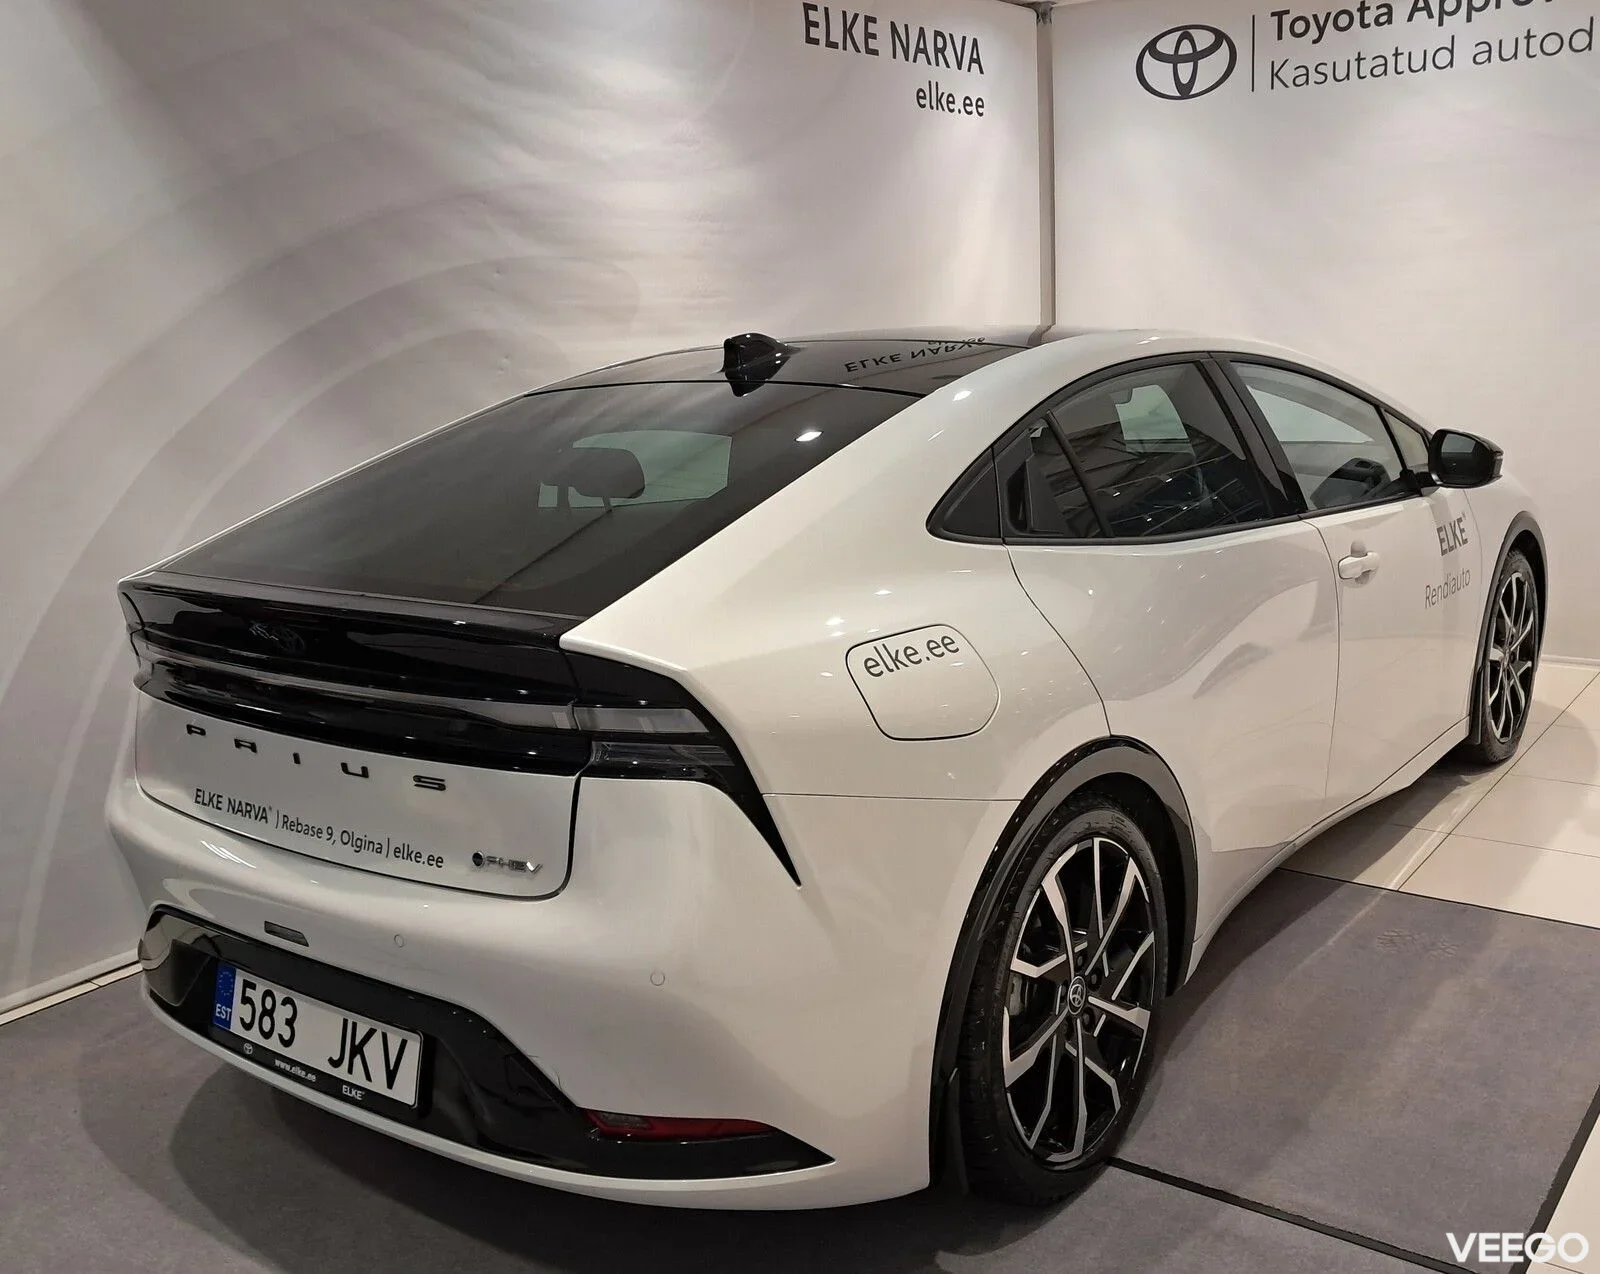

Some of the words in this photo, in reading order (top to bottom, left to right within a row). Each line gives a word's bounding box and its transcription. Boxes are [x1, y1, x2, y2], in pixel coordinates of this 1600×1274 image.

[803, 2, 879, 56] ELKE
[890, 21, 984, 74] NARVA
[1271, 0, 1394, 44] Toyota
[1407, 0, 1552, 27] App
[1270, 34, 1455, 90] Kasutatud
[1472, 16, 1594, 65] autod
[916, 80, 985, 117] elke.ee
[1437, 516, 1468, 556] ELKE
[1425, 568, 1470, 610] Rendiauto
[863, 635, 960, 678] elke.ee
[186, 724, 446, 791] PRIUS
[194, 788, 223, 811] ELKE
[227, 797, 269, 824] NARVA
[282, 814, 323, 839] Rebase
[340, 830, 383, 854] Olgina
[393, 843, 444, 868] elke.ee
[215, 1003, 232, 1021] EST
[239, 978, 298, 1048] 583
[327, 1017, 408, 1090] JKV
[274, 1059, 317, 1082] www.elke.ee
[342, 1085, 362, 1100] ELKE
